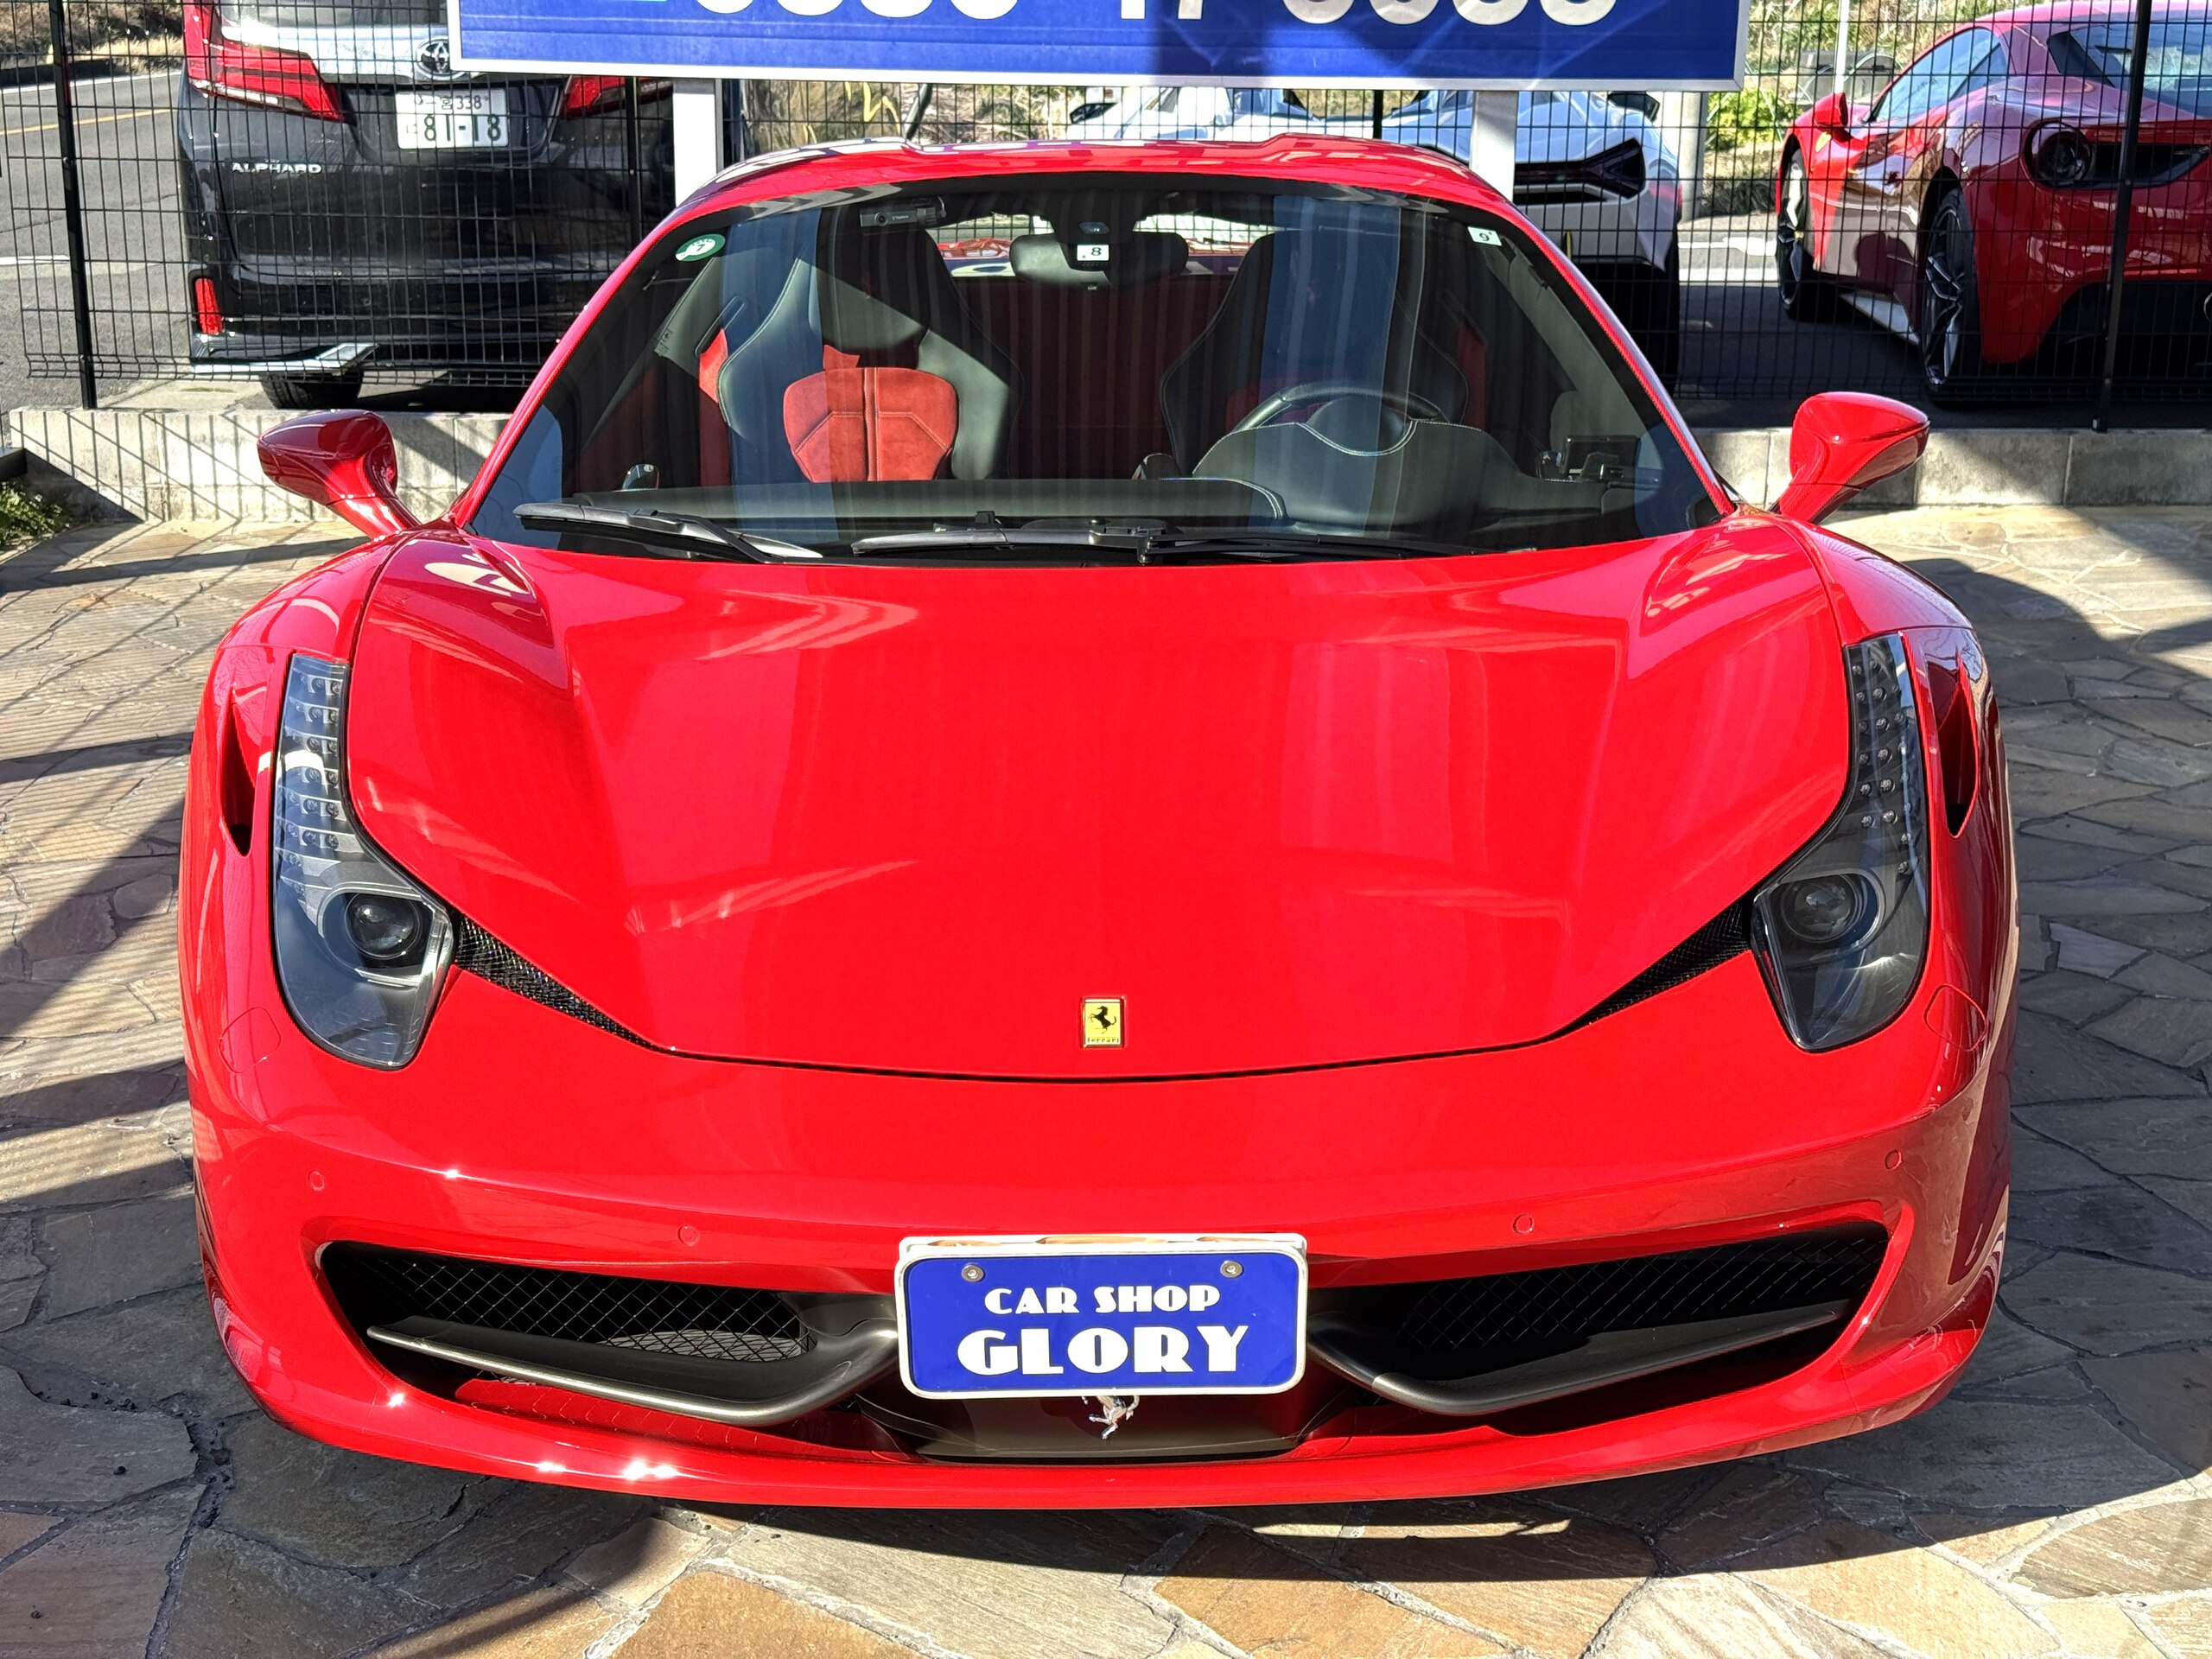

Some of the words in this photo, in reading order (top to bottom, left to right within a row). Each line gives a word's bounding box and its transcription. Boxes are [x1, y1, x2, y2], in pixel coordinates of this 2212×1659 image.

[455, 94, 482, 111] 338
[232, 161, 322, 174] ALPHARD
[1090, 246, 1102, 257] 8
[984, 1287, 1080, 1315] CAR
[1093, 1284, 1221, 1314] SHOP
[957, 1325, 1249, 1376] GLORY
